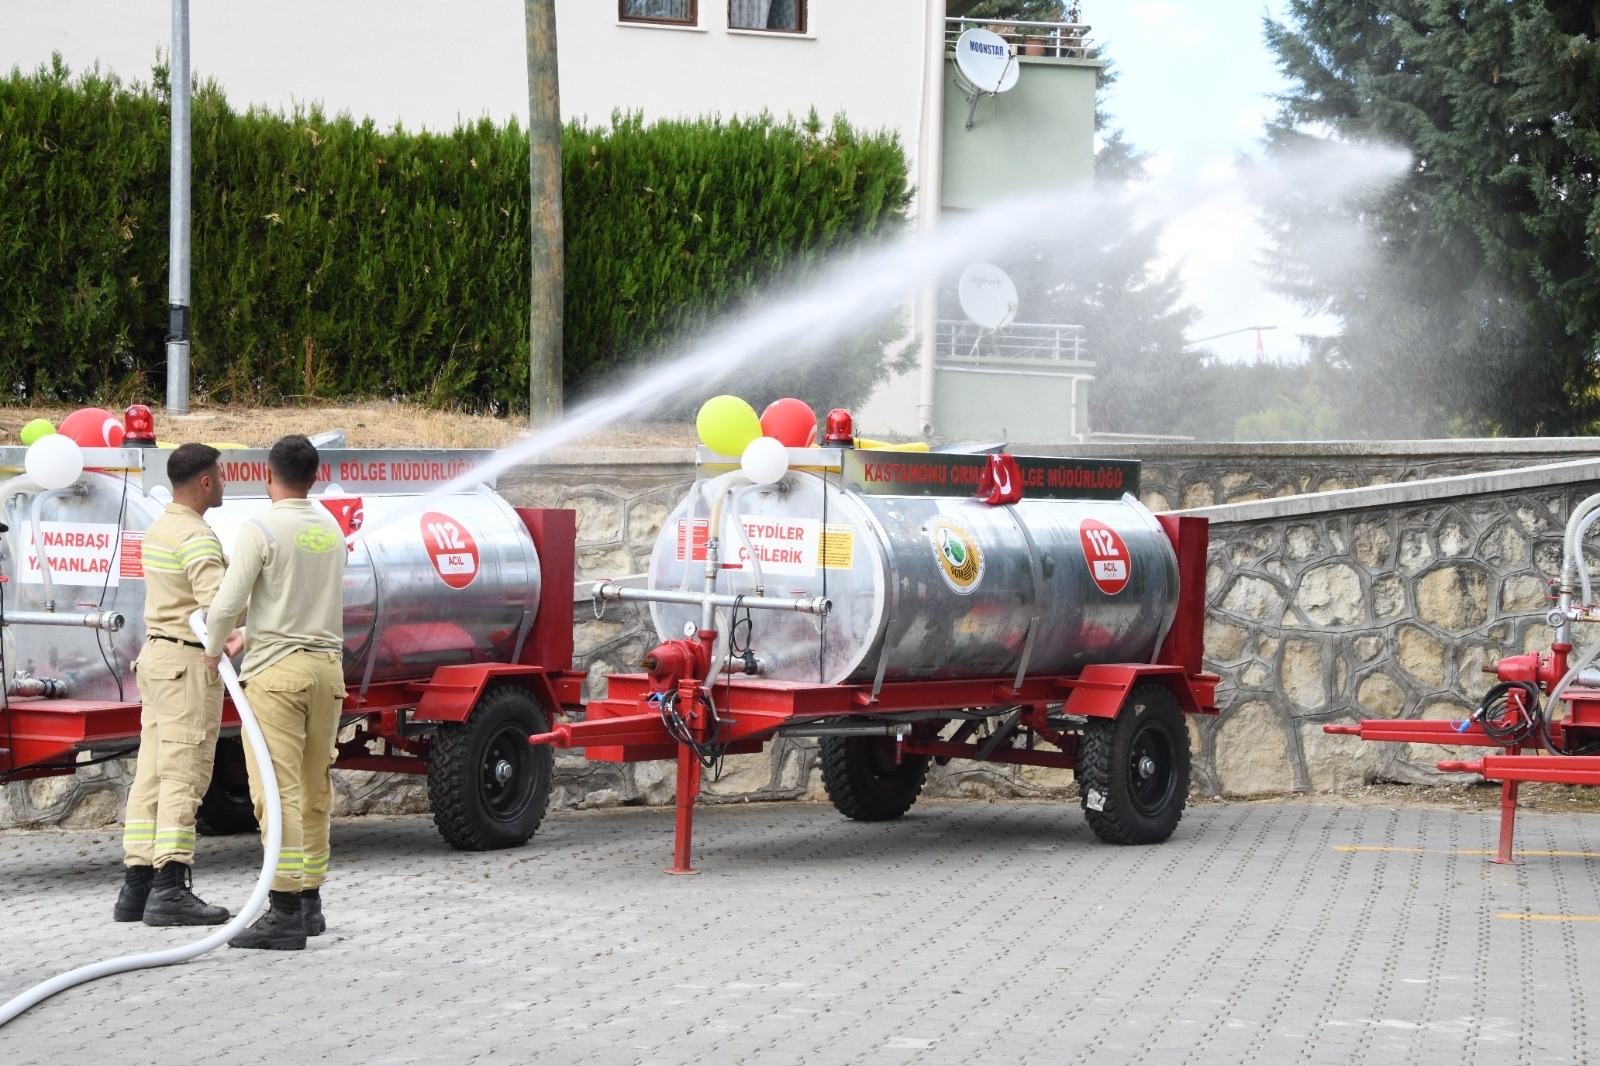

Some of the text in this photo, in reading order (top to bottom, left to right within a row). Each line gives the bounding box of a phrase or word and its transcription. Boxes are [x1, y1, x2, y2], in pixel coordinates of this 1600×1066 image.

[969, 40, 1004, 57] MOONSTAR
[340, 459, 387, 482] BÖLGE
[864, 463, 948, 484] KASTAMONU
[1048, 465, 1123, 489] MÜDÜRLÜĞÜ
[31, 531, 110, 550] NARBAŞI
[427, 521, 466, 550] 112
[1085, 529, 1120, 556] 112
[738, 544, 803, 564] ÇĞİLERİK
